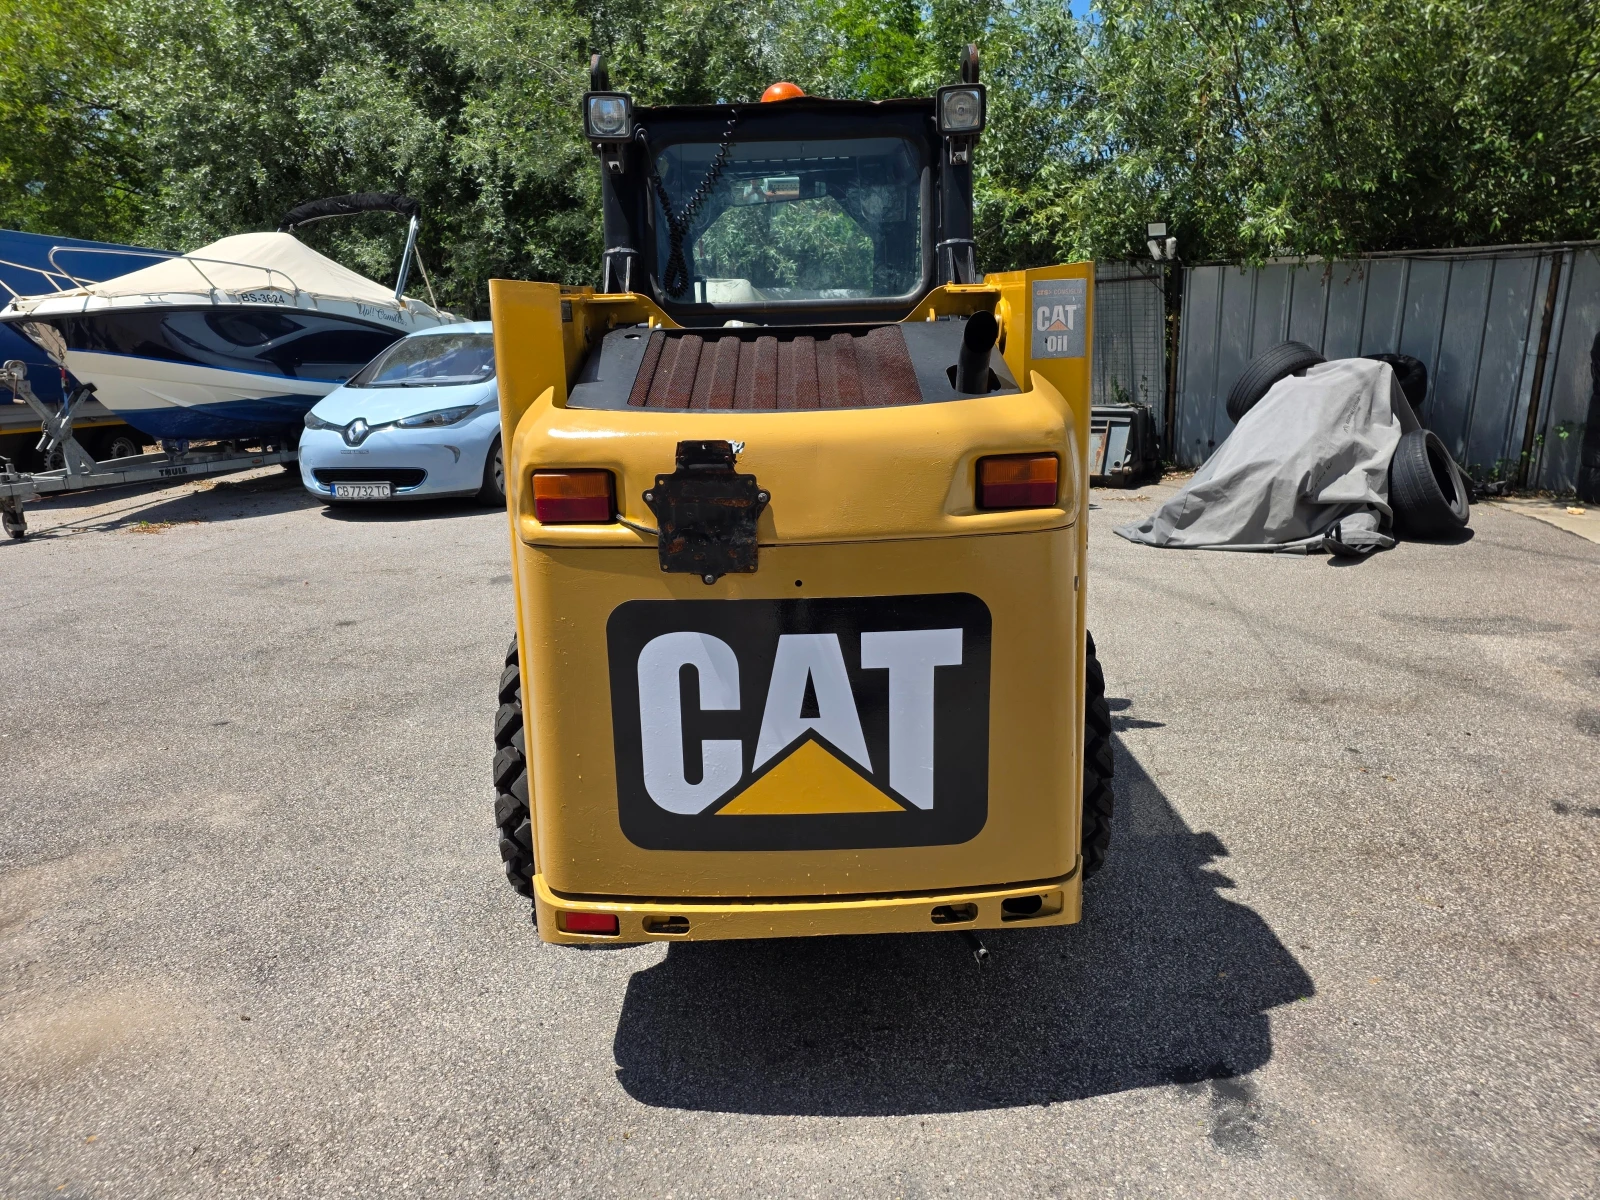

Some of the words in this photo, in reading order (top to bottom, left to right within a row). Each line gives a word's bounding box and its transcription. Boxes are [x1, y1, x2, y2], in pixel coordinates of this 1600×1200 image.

[241, 293, 285, 303] BS-3624
[1036, 304, 1077, 332] CAT
[1047, 335, 1068, 352] Oil
[159, 466, 187, 476] THULE
[637, 628, 963, 815] CAT
